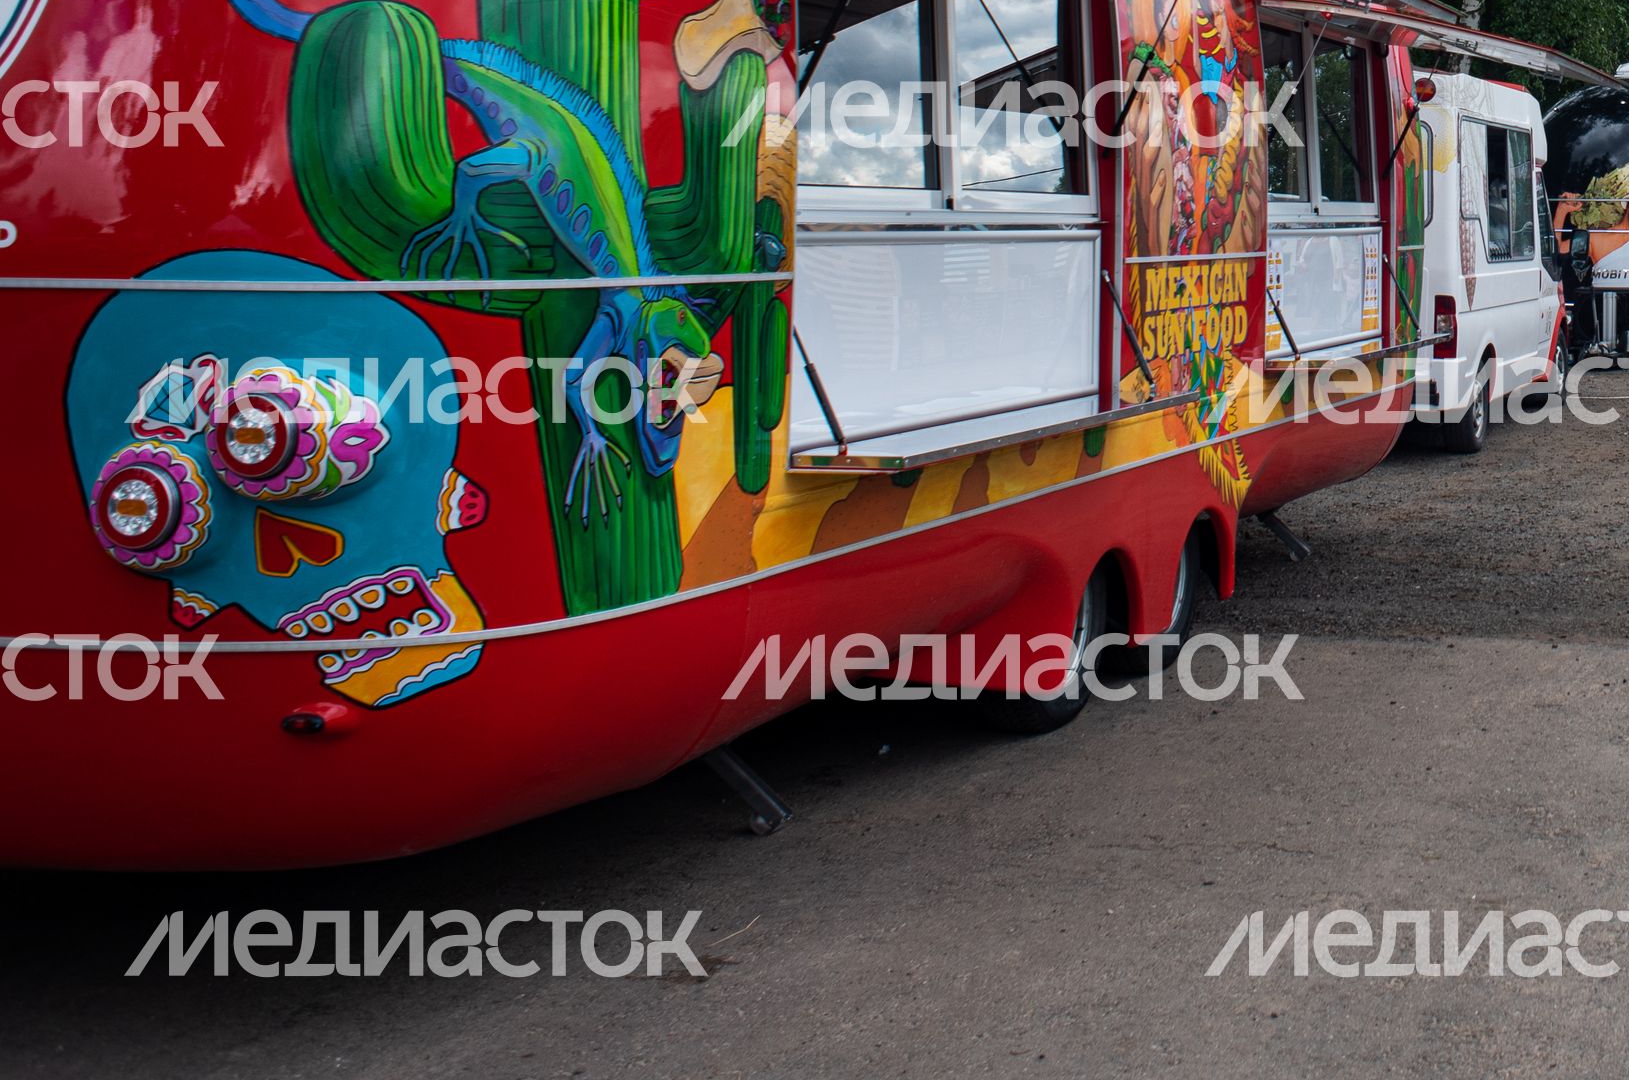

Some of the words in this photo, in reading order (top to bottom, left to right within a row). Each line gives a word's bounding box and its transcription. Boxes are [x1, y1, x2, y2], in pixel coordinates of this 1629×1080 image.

[1145, 262, 1248, 313] MEXICAN
[1143, 309, 1188, 360] SUN
[1192, 305, 1248, 353] FOOD
